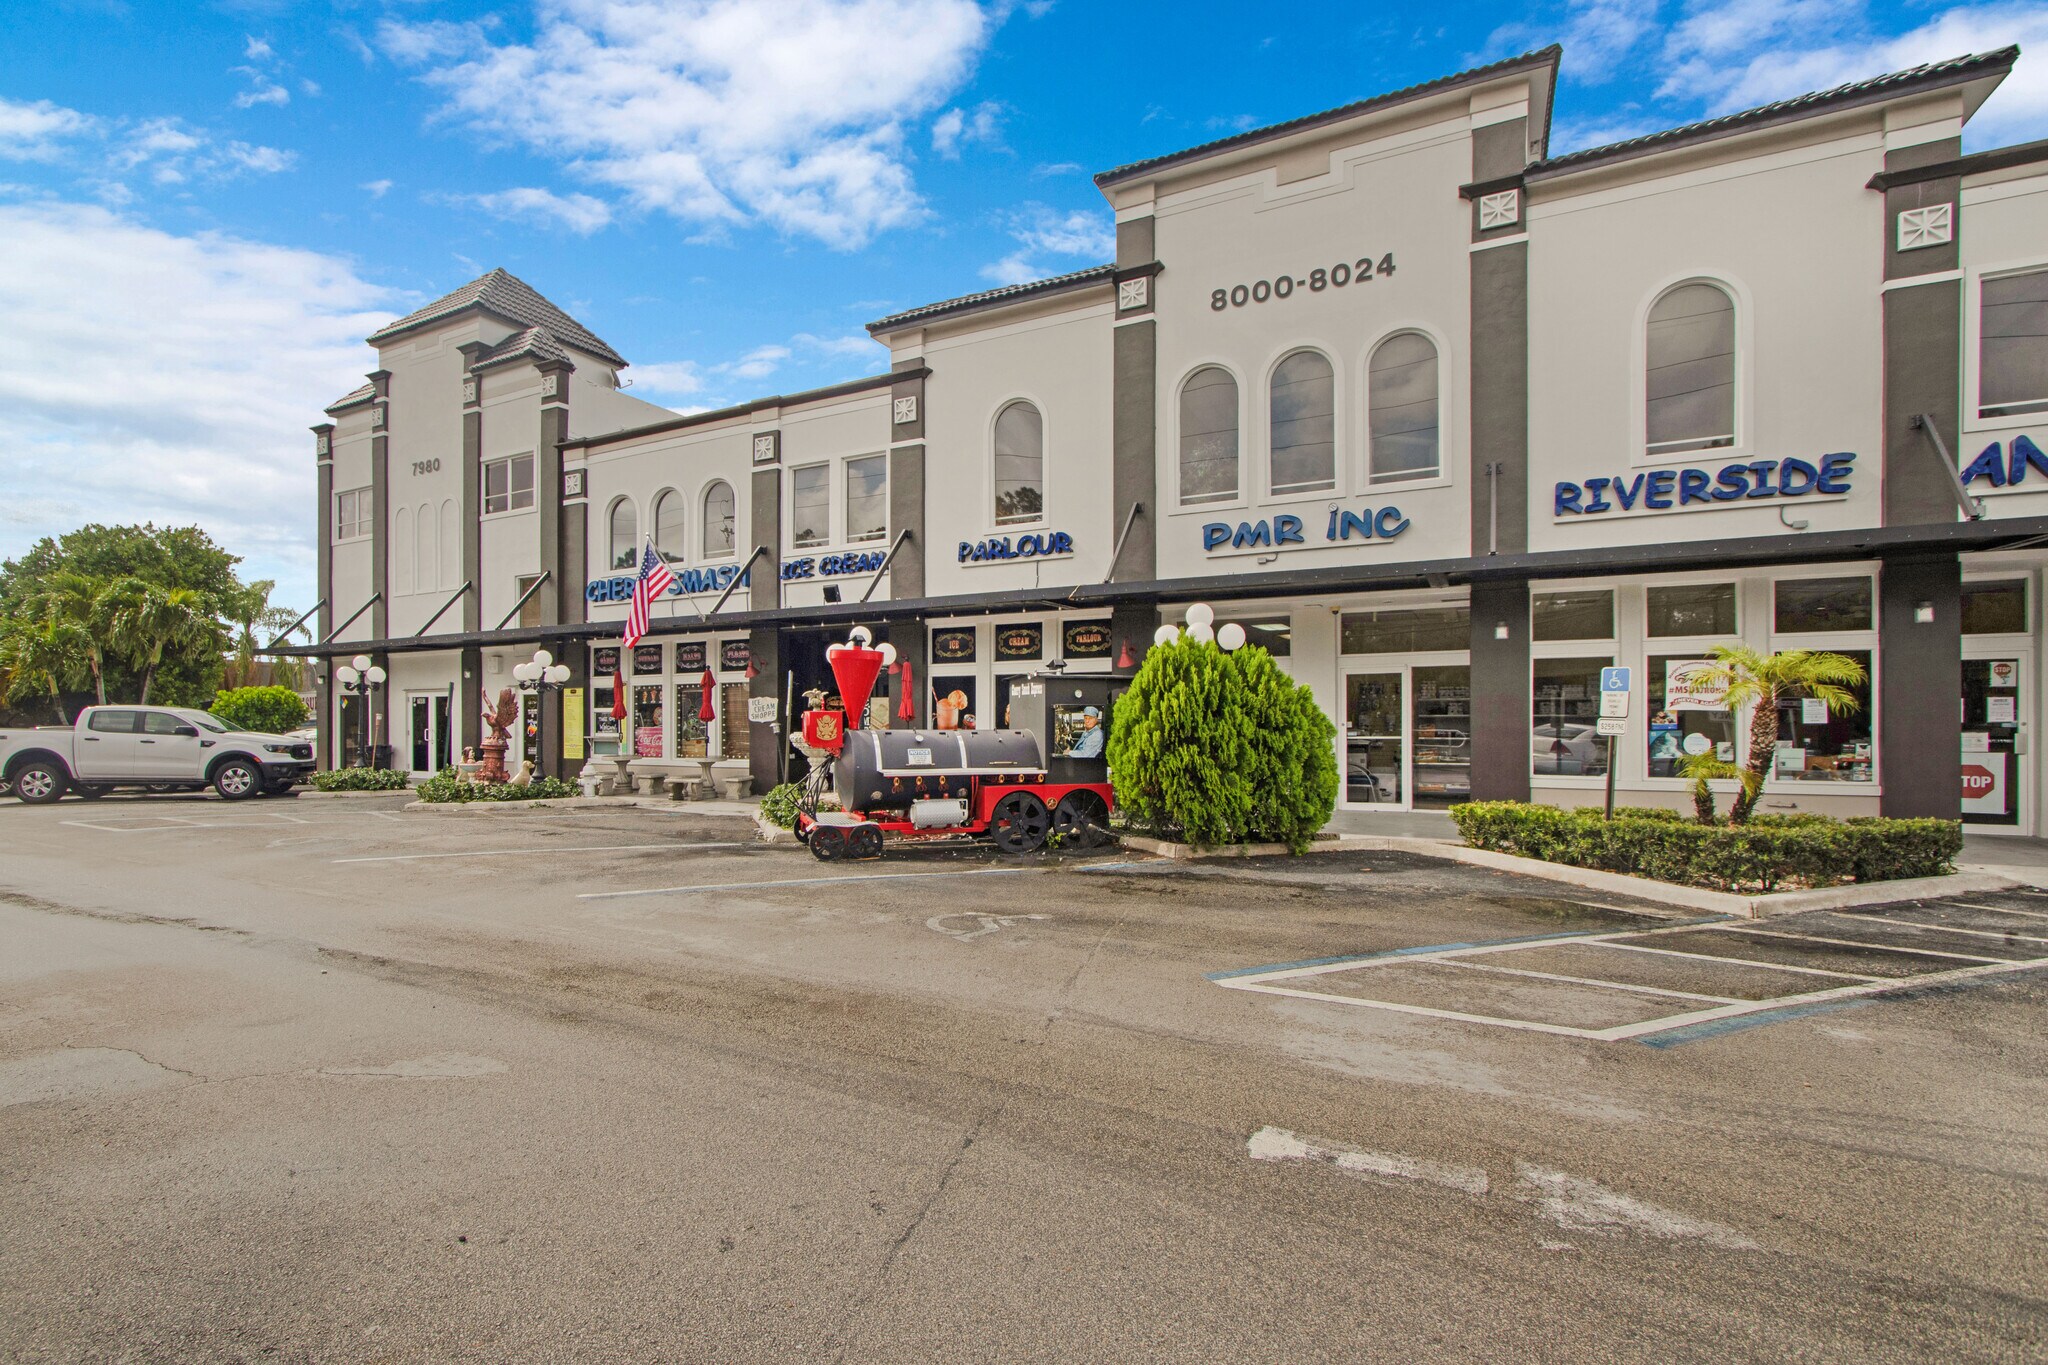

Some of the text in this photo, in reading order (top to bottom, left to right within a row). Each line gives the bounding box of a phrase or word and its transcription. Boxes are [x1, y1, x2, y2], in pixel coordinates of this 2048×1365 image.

[1210, 252, 1396, 312] 8000-8024
[412, 457, 440, 477] 7980
[1554, 452, 1857, 516] RIVERSIDE
[958, 532, 1074, 563] PARLOUR
[1203, 514, 1305, 552] PMR
[780, 550, 887, 579] ICE CREAM
[586, 566, 750, 601] CHER SMASH
[949, 640, 960, 649] ICE
[751, 711, 776, 720] SHOPPE
[754, 703, 775, 713] CREAM
[1961, 776, 1992, 788] TOP
